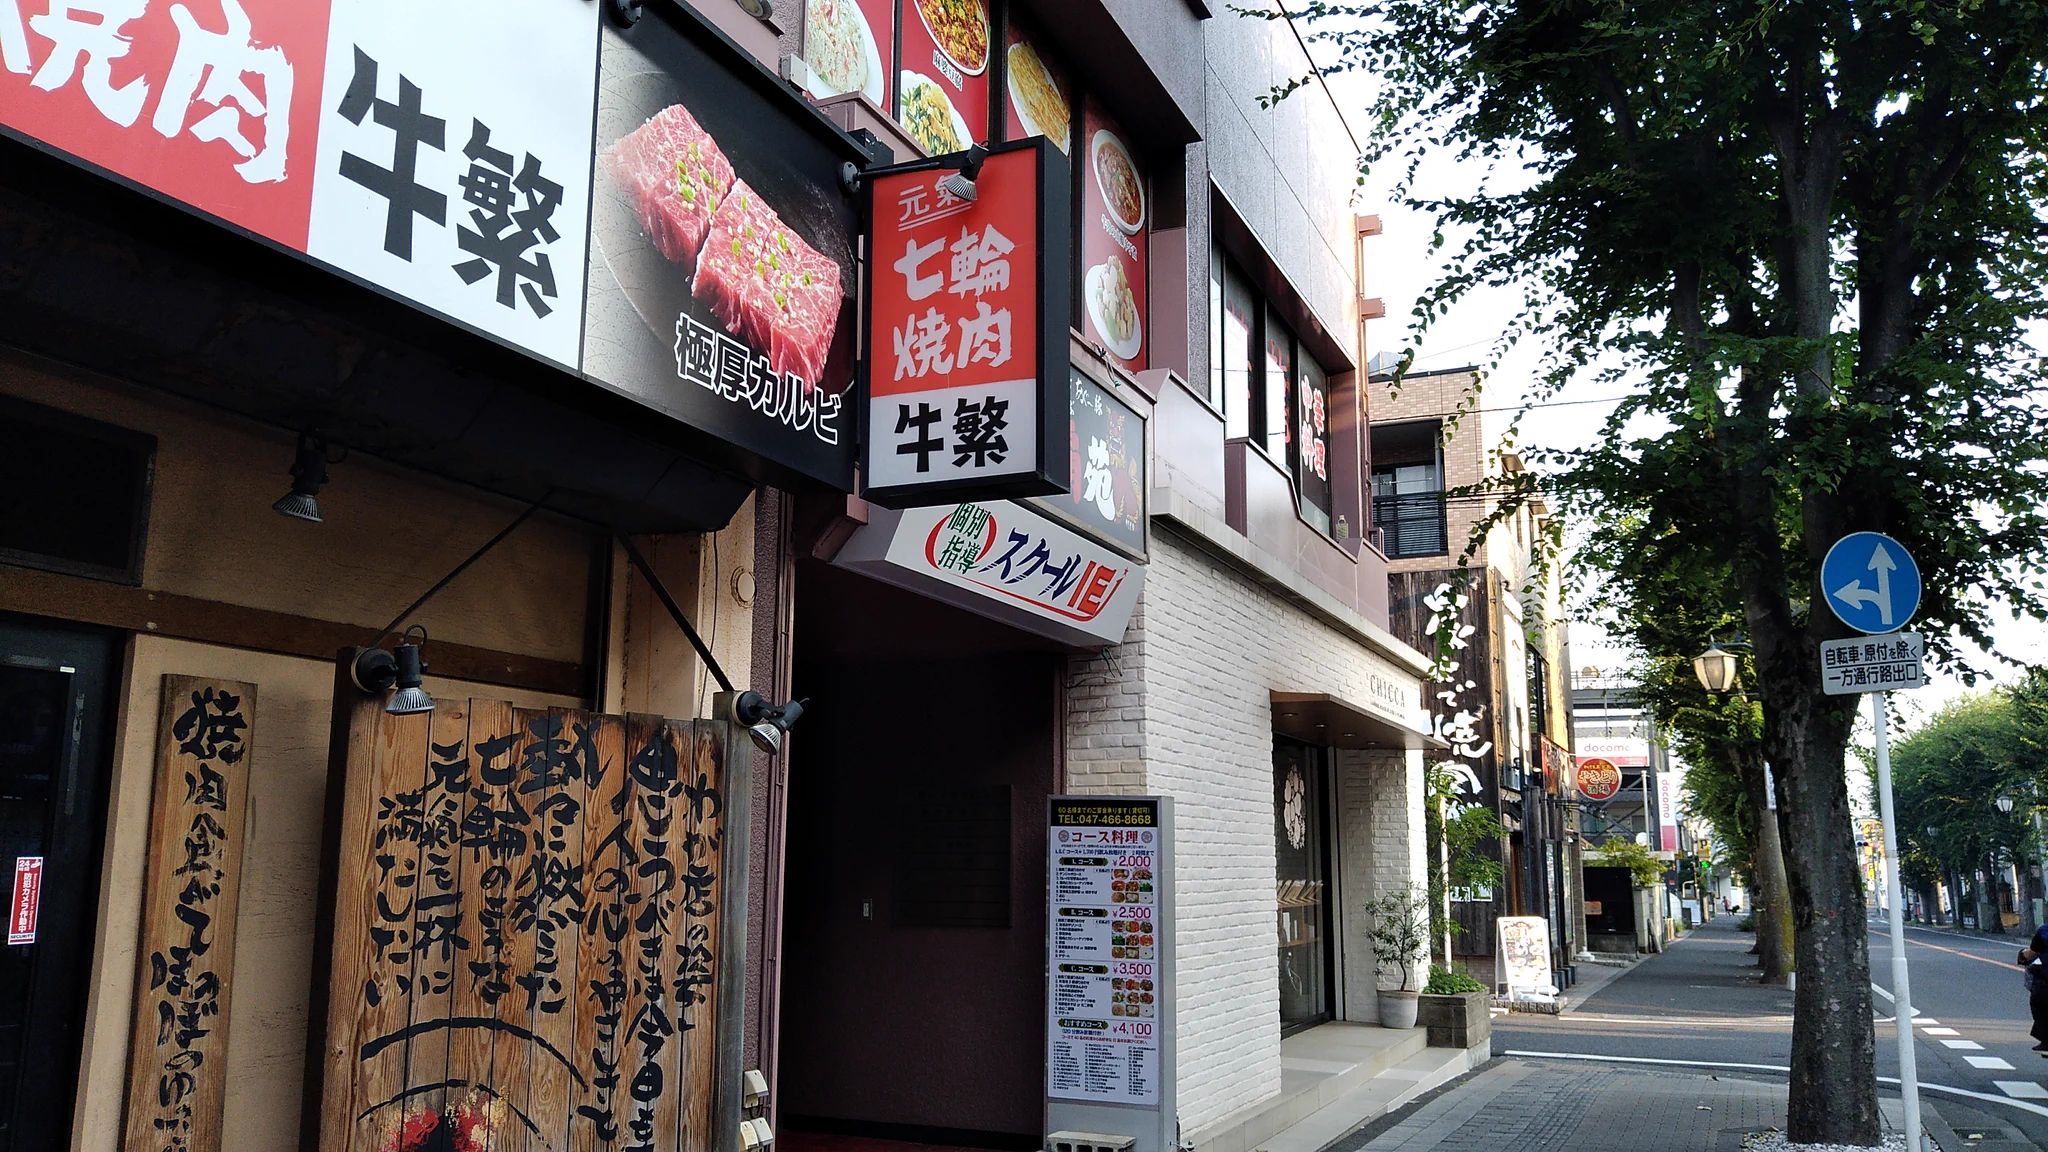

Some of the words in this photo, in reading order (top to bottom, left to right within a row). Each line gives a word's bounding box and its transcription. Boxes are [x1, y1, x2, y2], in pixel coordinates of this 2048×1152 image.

[337, 43, 564, 319] 牛繁
[893, 223, 1015, 301] 七輪
[893, 301, 1012, 381] 焼肉
[674, 312, 842, 445] 極厚カルビ
[894, 396, 1009, 473] 牛繁
[947, 502, 991, 539] 個別
[937, 535, 983, 574] 指導
[1825, 641, 1918, 666] 自転車・原付を除く
[1828, 663, 1918, 687] 一方通行路出口
[1370, 674, 1406, 708] CHICCA
[1584, 742, 1631, 752] docomo
[1579, 769, 1617, 785] やきとり
[1587, 784, 1610, 796] 酒場
[1661, 779, 1670, 819] docomo
[1058, 815, 1151, 825] TEL:047-466-8668
[1071, 830, 1138, 844] コース料理
[1700, 839, 1708, 849] P
[1112, 855, 1151, 867] ¥2,000
[1112, 907, 1151, 919] ¥2,500
[1112, 963, 1152, 975] ¥3,500
[1112, 1022, 1152, 1036] ¥4,100
